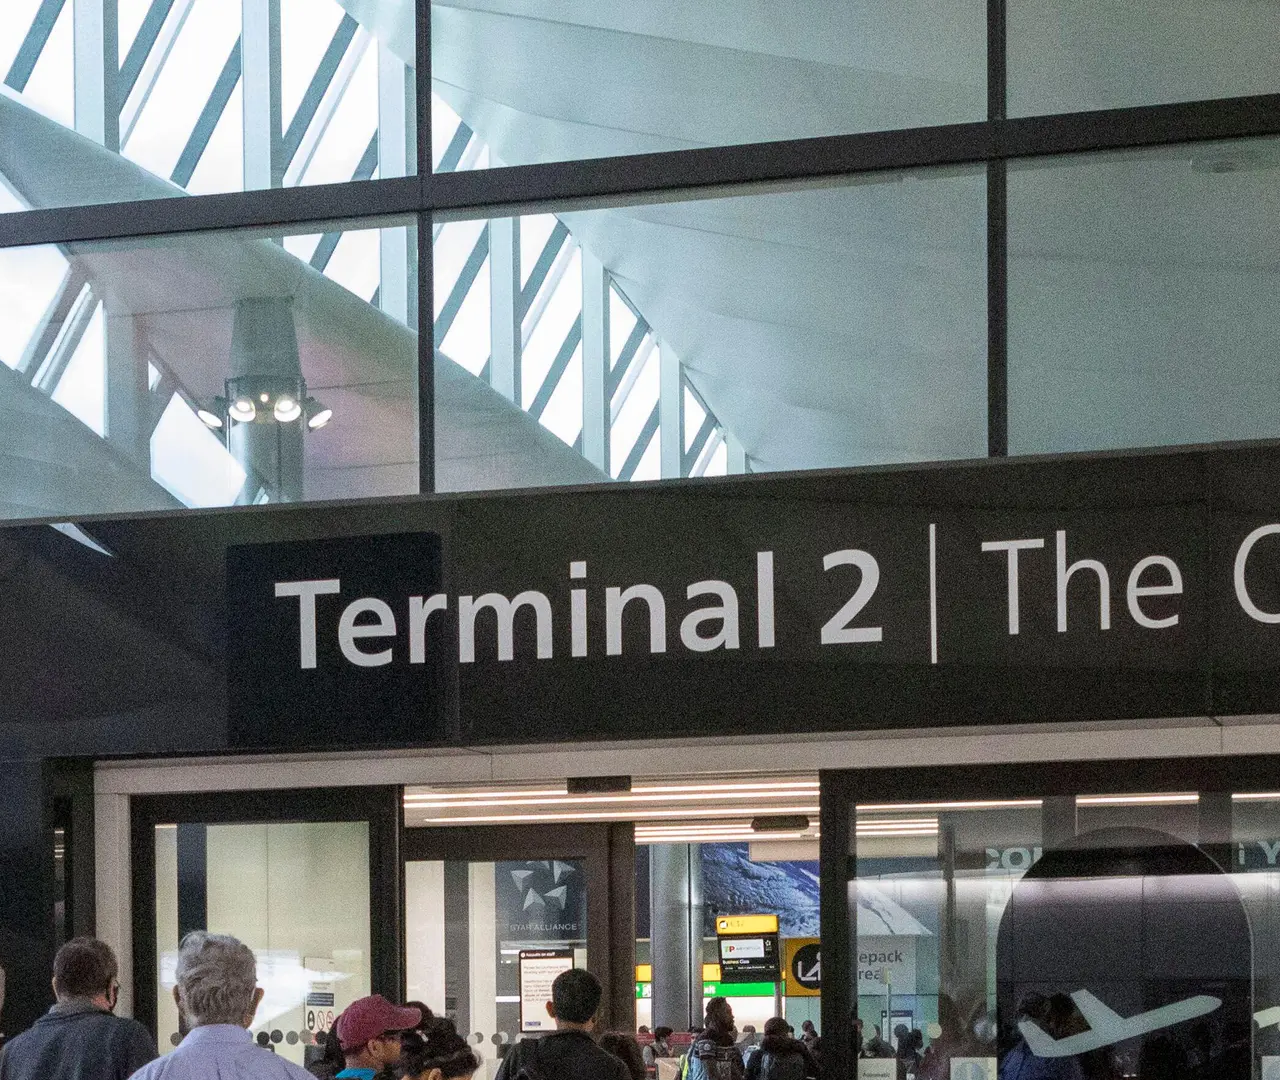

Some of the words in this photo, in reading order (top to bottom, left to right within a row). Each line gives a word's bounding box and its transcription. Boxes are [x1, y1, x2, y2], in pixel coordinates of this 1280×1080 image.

[273, 546, 777, 669] Terminal
[820, 548, 883, 645] 2
[981, 530, 1184, 635] The
[533, 923, 578, 931] ALLIANCE
[858, 950, 903, 968] epack
